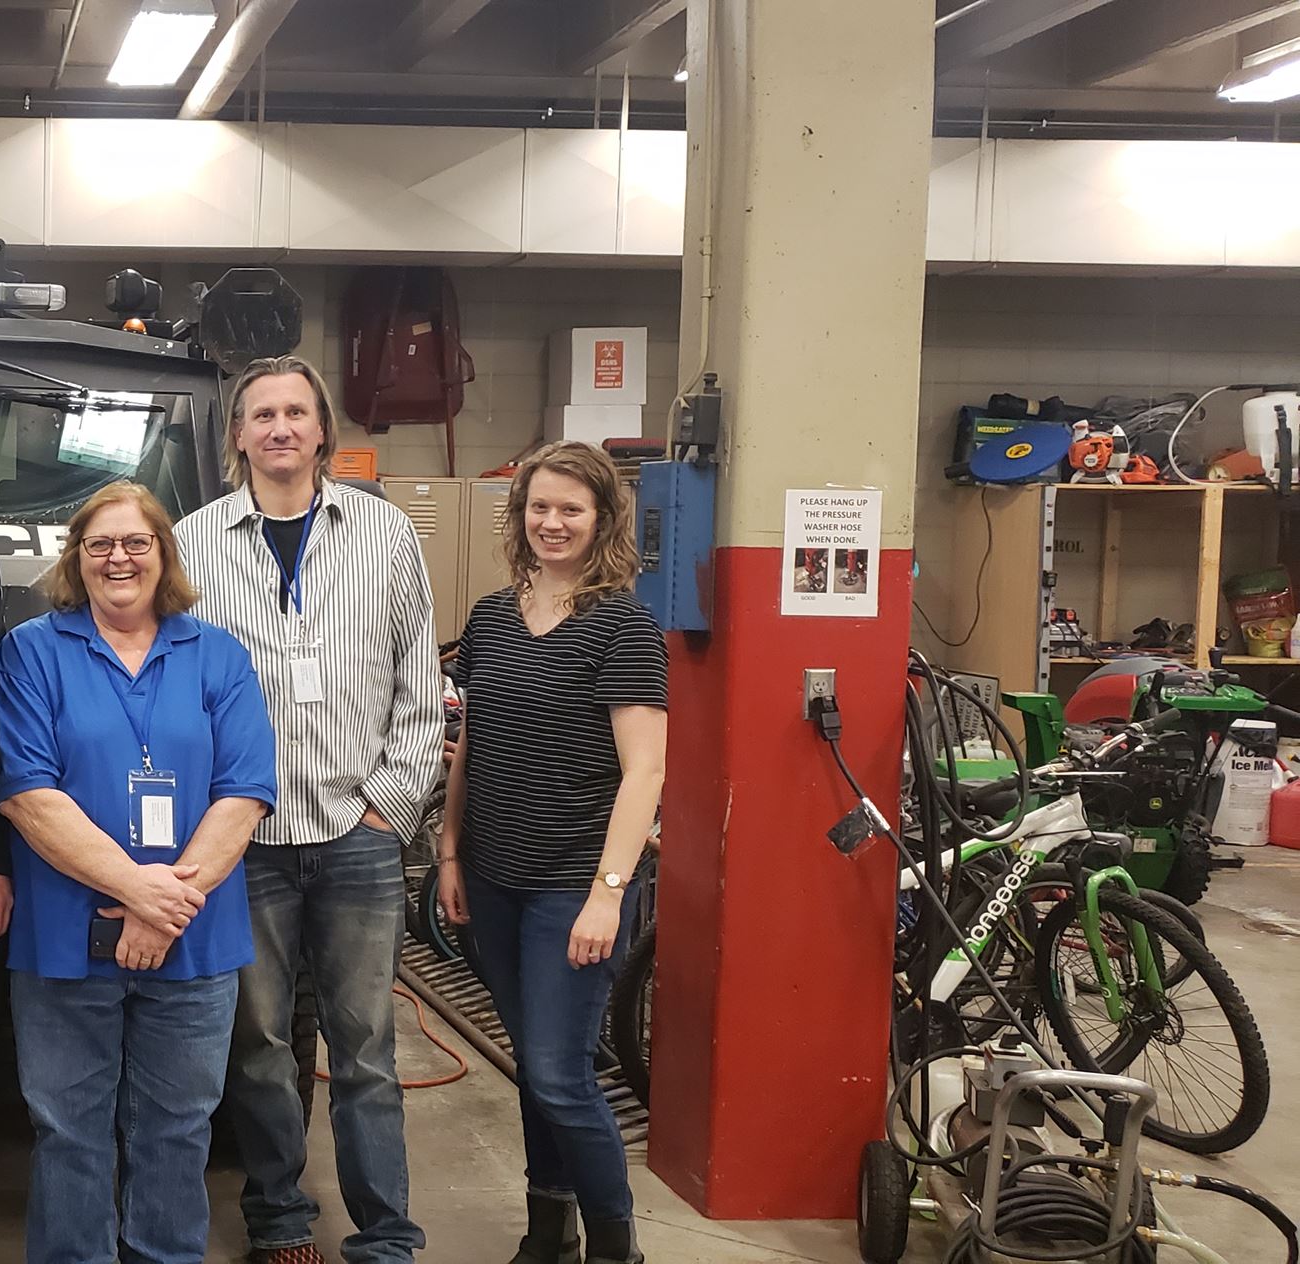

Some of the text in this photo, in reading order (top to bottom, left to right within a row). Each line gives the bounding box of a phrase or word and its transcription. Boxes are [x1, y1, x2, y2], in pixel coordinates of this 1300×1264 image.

[800, 498, 829, 506] PLEASE
[831, 498, 854, 506] HANG
[805, 510, 862, 519] THE PRESSURE
[804, 523, 862, 531] WASHER HOSE
[806, 536, 860, 544] WHEN DONE.
[1232, 759, 1251, 771] Ice
[958, 849, 1038, 961] mongoose
